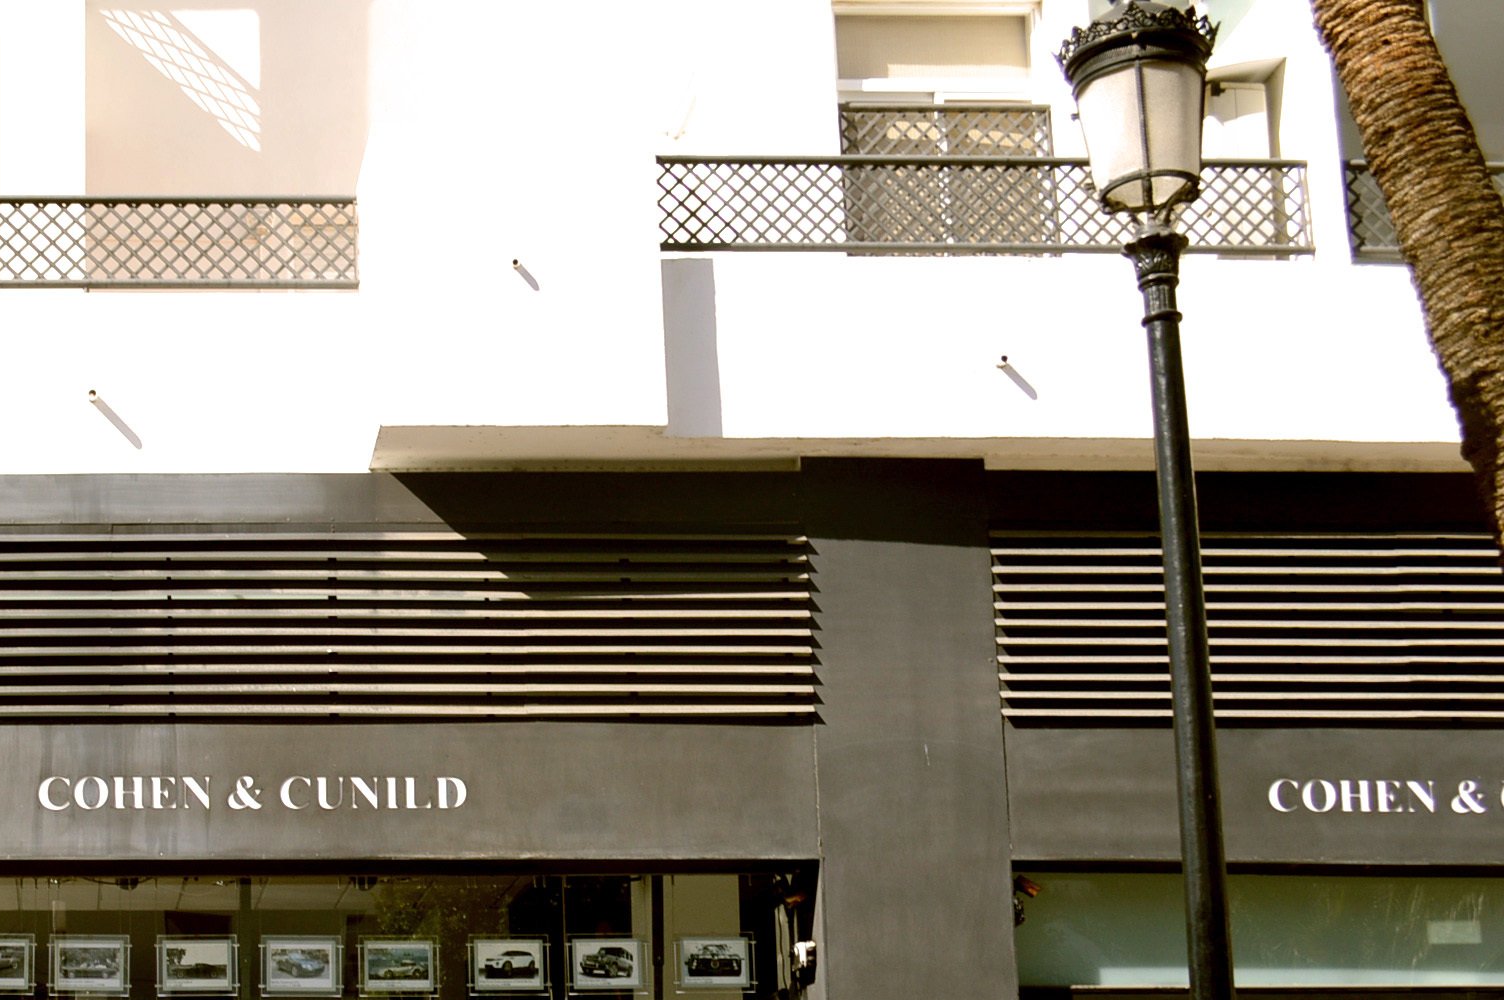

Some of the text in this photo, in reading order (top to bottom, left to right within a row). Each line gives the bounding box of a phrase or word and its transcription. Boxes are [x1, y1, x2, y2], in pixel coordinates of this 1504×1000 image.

[37, 775, 468, 811] COHEN & CUNILD
[1267, 778, 1435, 813] COHEN
[1451, 780, 1487, 814] &
